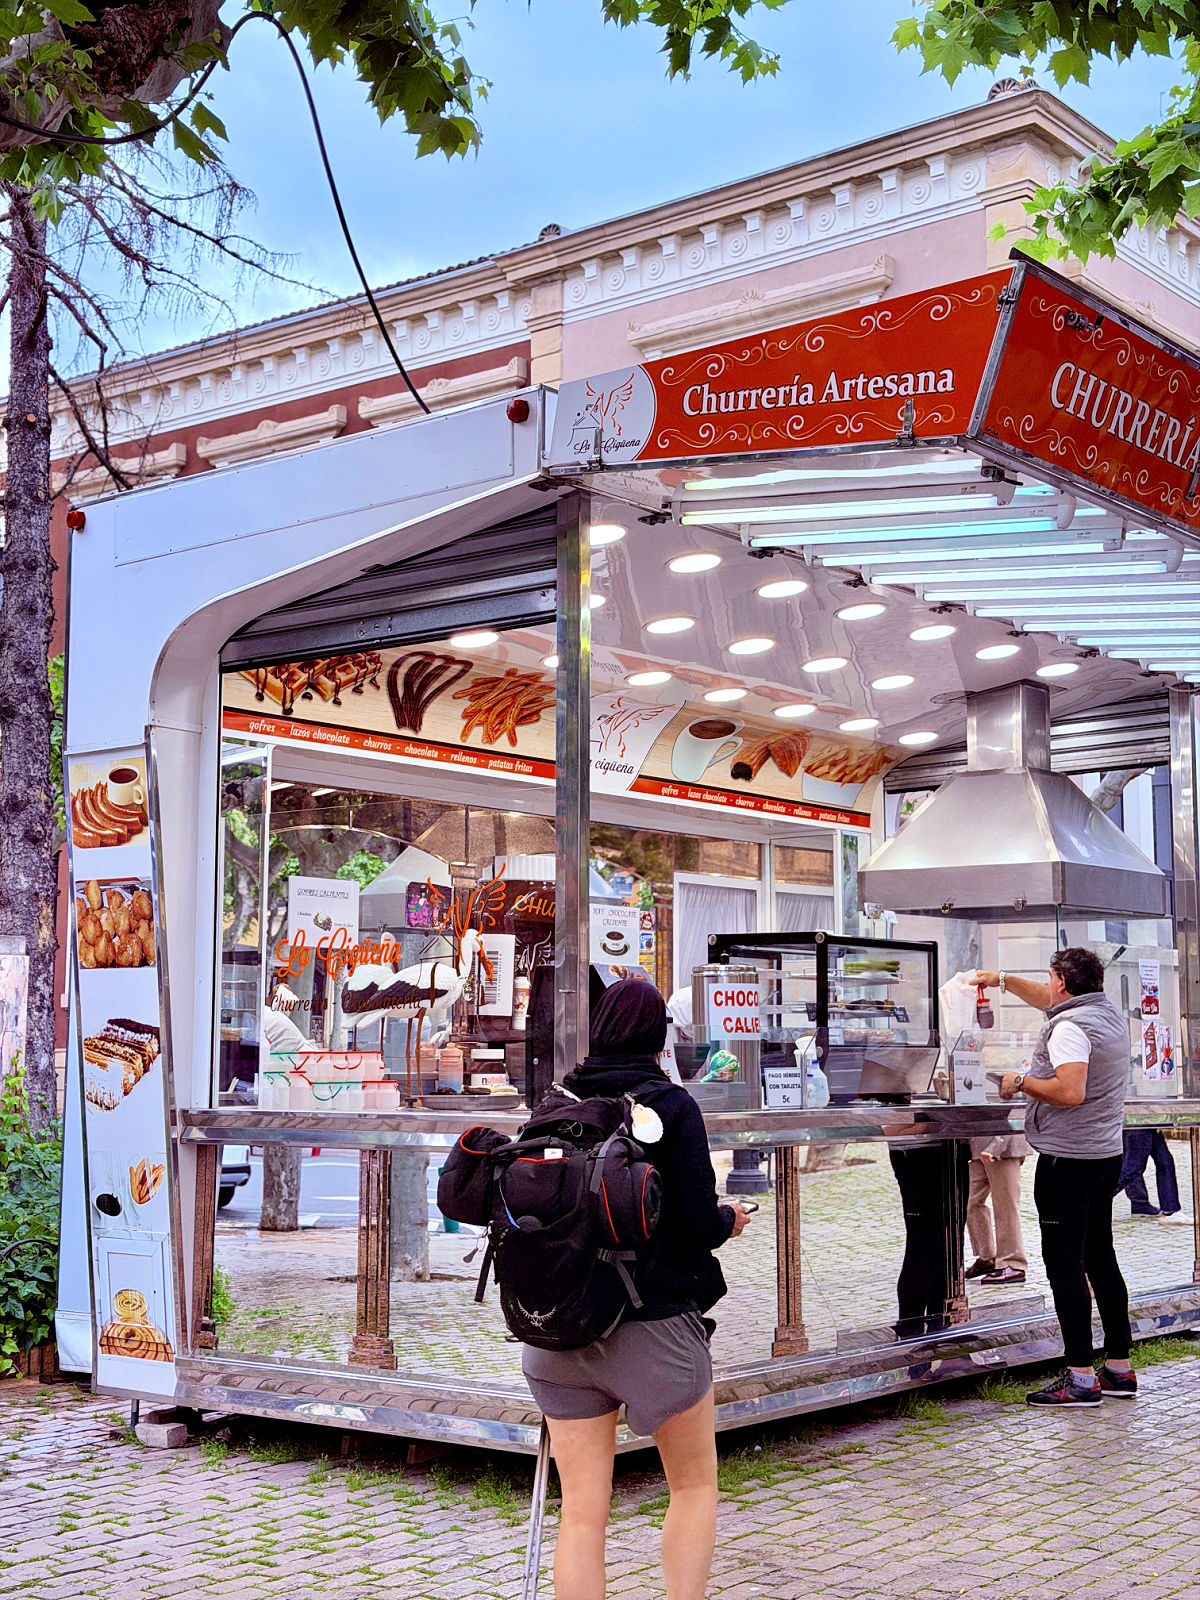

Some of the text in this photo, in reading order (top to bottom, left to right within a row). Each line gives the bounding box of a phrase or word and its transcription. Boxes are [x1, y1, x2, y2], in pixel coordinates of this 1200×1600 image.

[682, 369, 954, 416] Churrería Artesana
[574, 439, 591, 455] La
[249, 720, 533, 773] gofres lazos chocolate churros chocolate rellenos patatas fritas
[594, 758, 635, 775] cigüeña
[661, 785, 679, 796] gofres
[702, 791, 728, 803] chocolate
[276, 927, 403, 983] La Cigüeña
